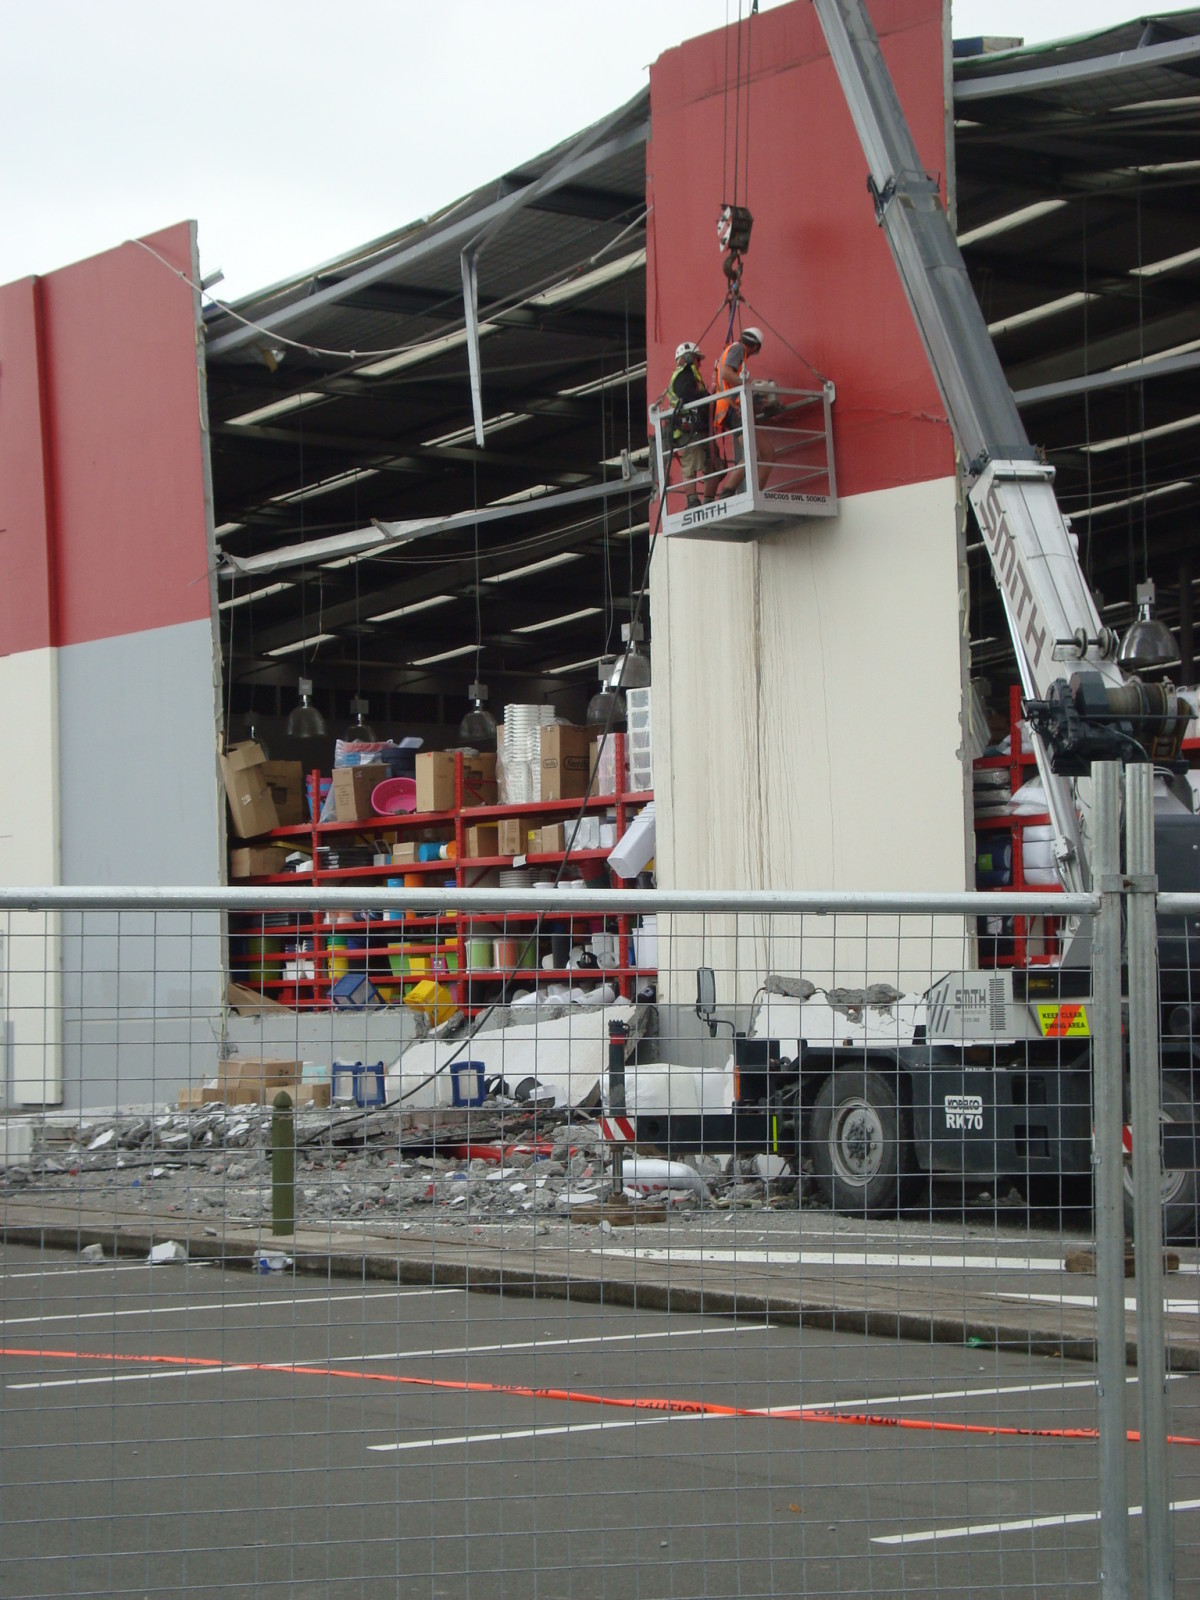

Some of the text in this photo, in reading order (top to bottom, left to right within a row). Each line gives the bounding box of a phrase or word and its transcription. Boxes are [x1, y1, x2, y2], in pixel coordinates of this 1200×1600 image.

[790, 494, 805, 502] SWL
[681, 502, 728, 526] SMITH
[979, 487, 1047, 669] SMITH
[954, 989, 987, 1009] SMITH
[947, 1099, 980, 1110] KOBELCO
[946, 1113, 984, 1130] RK70
